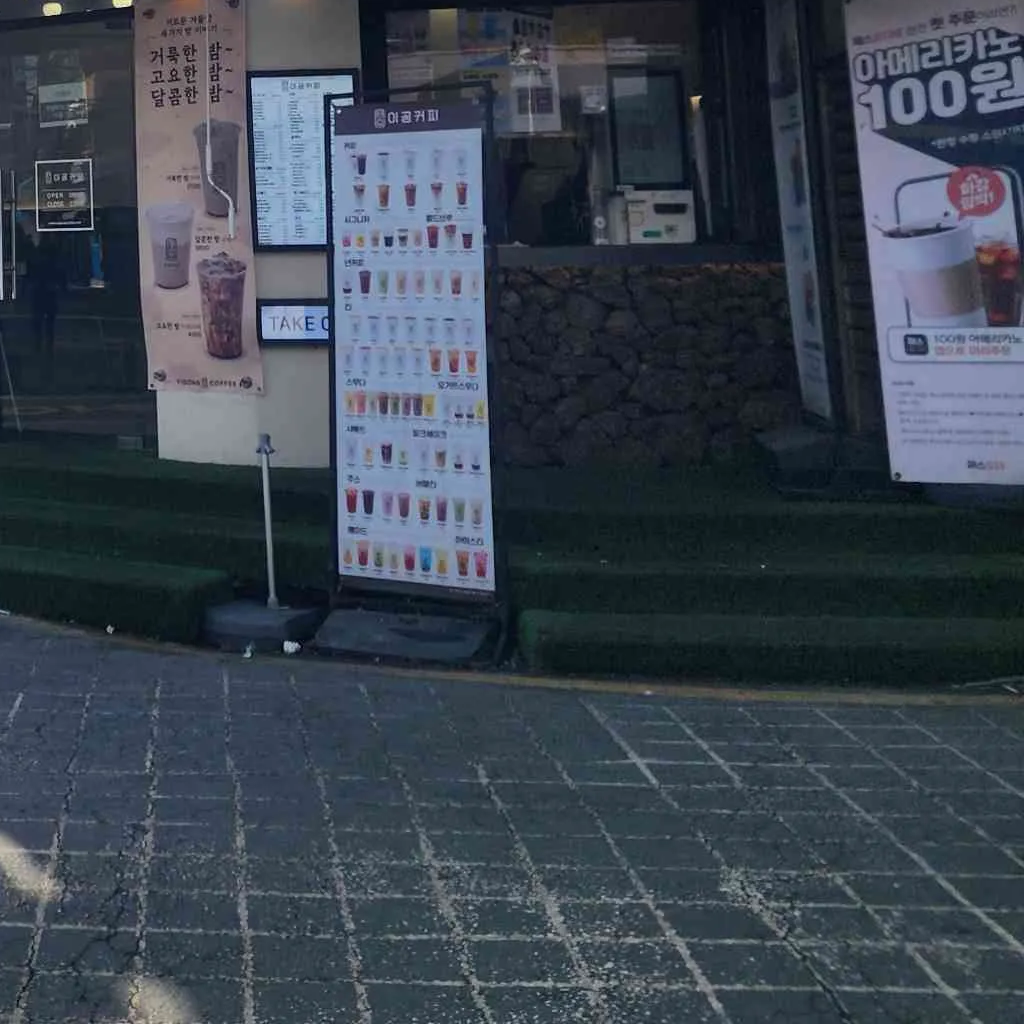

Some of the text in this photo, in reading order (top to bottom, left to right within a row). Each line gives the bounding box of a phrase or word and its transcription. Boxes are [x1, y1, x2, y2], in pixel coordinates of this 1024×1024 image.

[150, 44, 197, 65] 거룩한
[853, 26, 1023, 84] 아메리카노
[150, 65, 197, 84] 고요한
[151, 86, 198, 108] 달콤한
[857, 56, 1024, 130] 100원
[387, 109, 440, 124] 이공커피
[268, 315, 316, 332] TAKE
